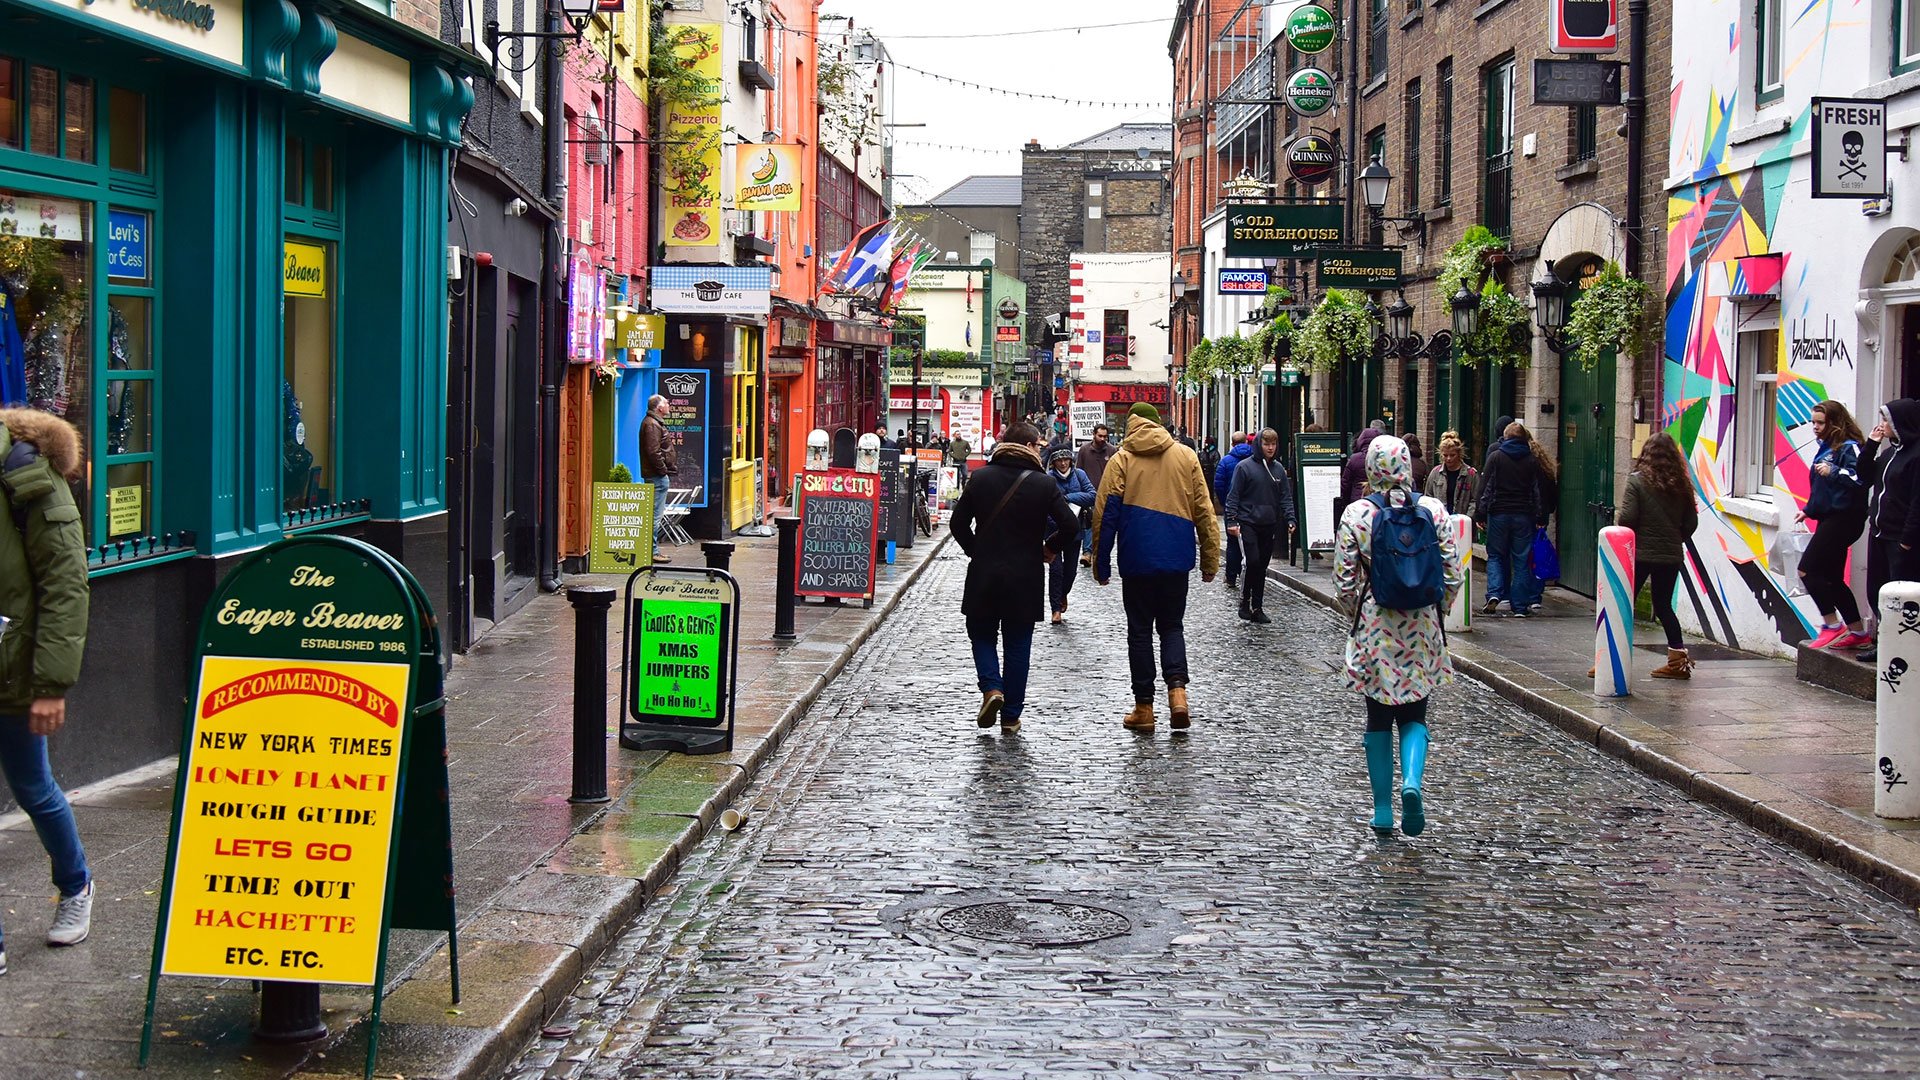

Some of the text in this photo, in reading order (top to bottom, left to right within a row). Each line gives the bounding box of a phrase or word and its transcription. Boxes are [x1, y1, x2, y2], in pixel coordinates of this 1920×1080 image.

[1289, 87, 1331, 96] Heineken
[669, 113, 718, 124] Pizzeria
[1824, 107, 1880, 126] FRESH
[1290, 151, 1333, 162] GUINNESS
[1229, 214, 1275, 227] The OLD
[108, 221, 140, 243] Levi's
[1233, 229, 1339, 240] STOREHOUSE
[286, 254, 320, 283] Beaver
[1323, 267, 1396, 276] STOREHOUSE
[1222, 273, 1264, 282] FAMOUS
[1222, 282, 1238, 290] FISH
[1243, 282, 1264, 290] CHIPS
[627, 331, 654, 339] JAM ART
[627, 339, 653, 348] FACTORY
[566, 373, 578, 534] SKATE CITY
[804, 474, 844, 494] SKATE
[601, 490, 646, 501] DESIGN MAKES
[606, 502, 640, 512] YOU HAPPY
[807, 500, 873, 516] SKATEBOARDS
[603, 515, 643, 526] IRISH DESIGN
[808, 513, 872, 529] LONGBOARDS
[604, 528, 640, 537] MAKES YOU
[805, 527, 864, 542] CRUISERS
[608, 540, 635, 549] HAPPIER
[804, 540, 871, 554] ROLLERBLADES
[803, 553, 870, 570] SCOOTERS
[289, 565, 335, 587] The
[800, 572, 869, 588] AND SPARES
[644, 580, 720, 596] Eager Beaver
[217, 599, 404, 634] Eager Beaver
[645, 614, 715, 635] LADIES & GENTS
[301, 638, 406, 652] ESTABLISHED 1986
[658, 642, 699, 658] XMAS
[645, 662, 710, 680] JUMPERS
[212, 673, 390, 718] RECOMMENDED BY
[652, 694, 664, 707] Ho
[667, 695, 681, 708] Ho
[683, 696, 696, 708] Ho
[200, 732, 393, 756] NEW YORK TIMES
[195, 766, 389, 792] LONELY PLANET
[200, 801, 377, 826] ROUGH GUIDE
[214, 838, 352, 862] LETS GO
[204, 874, 356, 900] TIME OUT
[194, 909, 356, 934] HACHETTE
[225, 947, 324, 969] ETC. ETC.
